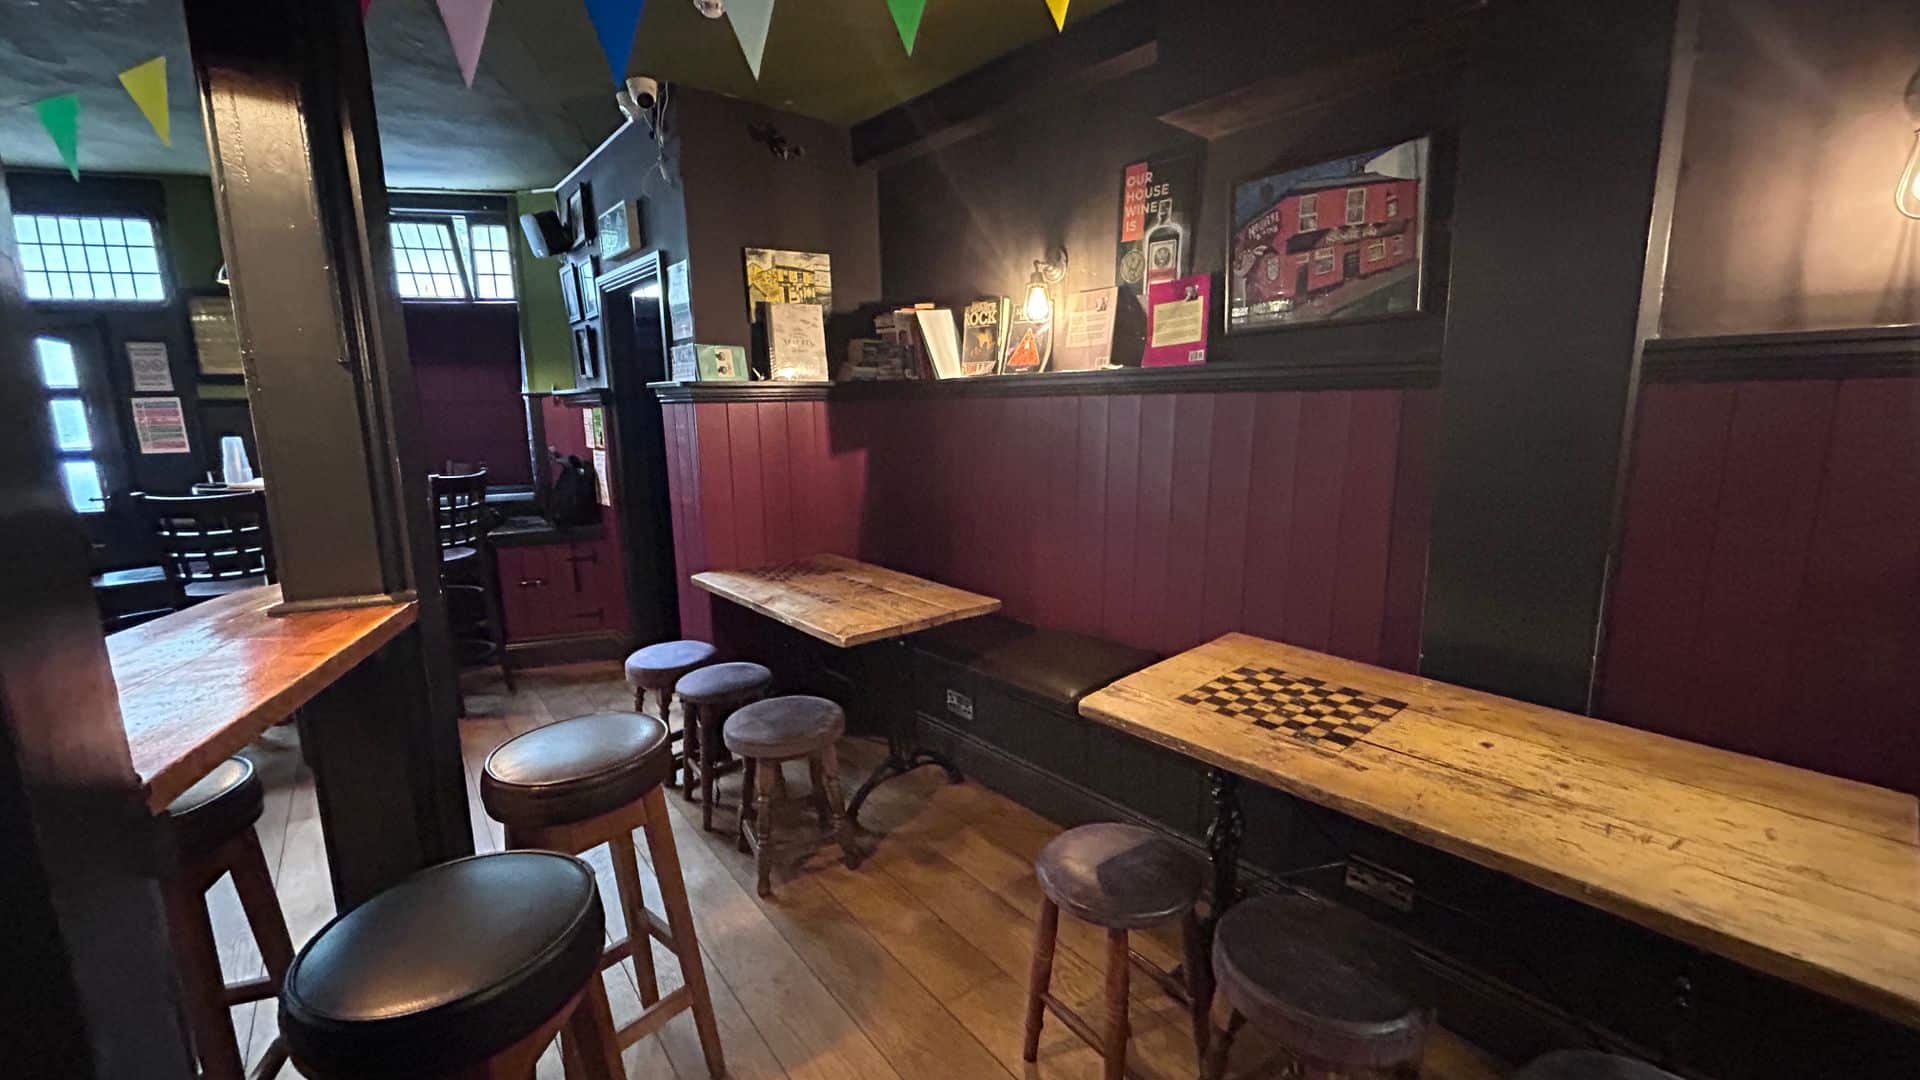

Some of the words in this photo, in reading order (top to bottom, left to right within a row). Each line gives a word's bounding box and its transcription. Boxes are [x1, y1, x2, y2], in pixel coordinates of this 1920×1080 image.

[1127, 172, 1153, 186] OUR
[1126, 183, 1169, 203] HOUSE
[1125, 201, 1158, 216] WINE
[1126, 220, 1137, 232] IS
[965, 311, 997, 326] ROCK
